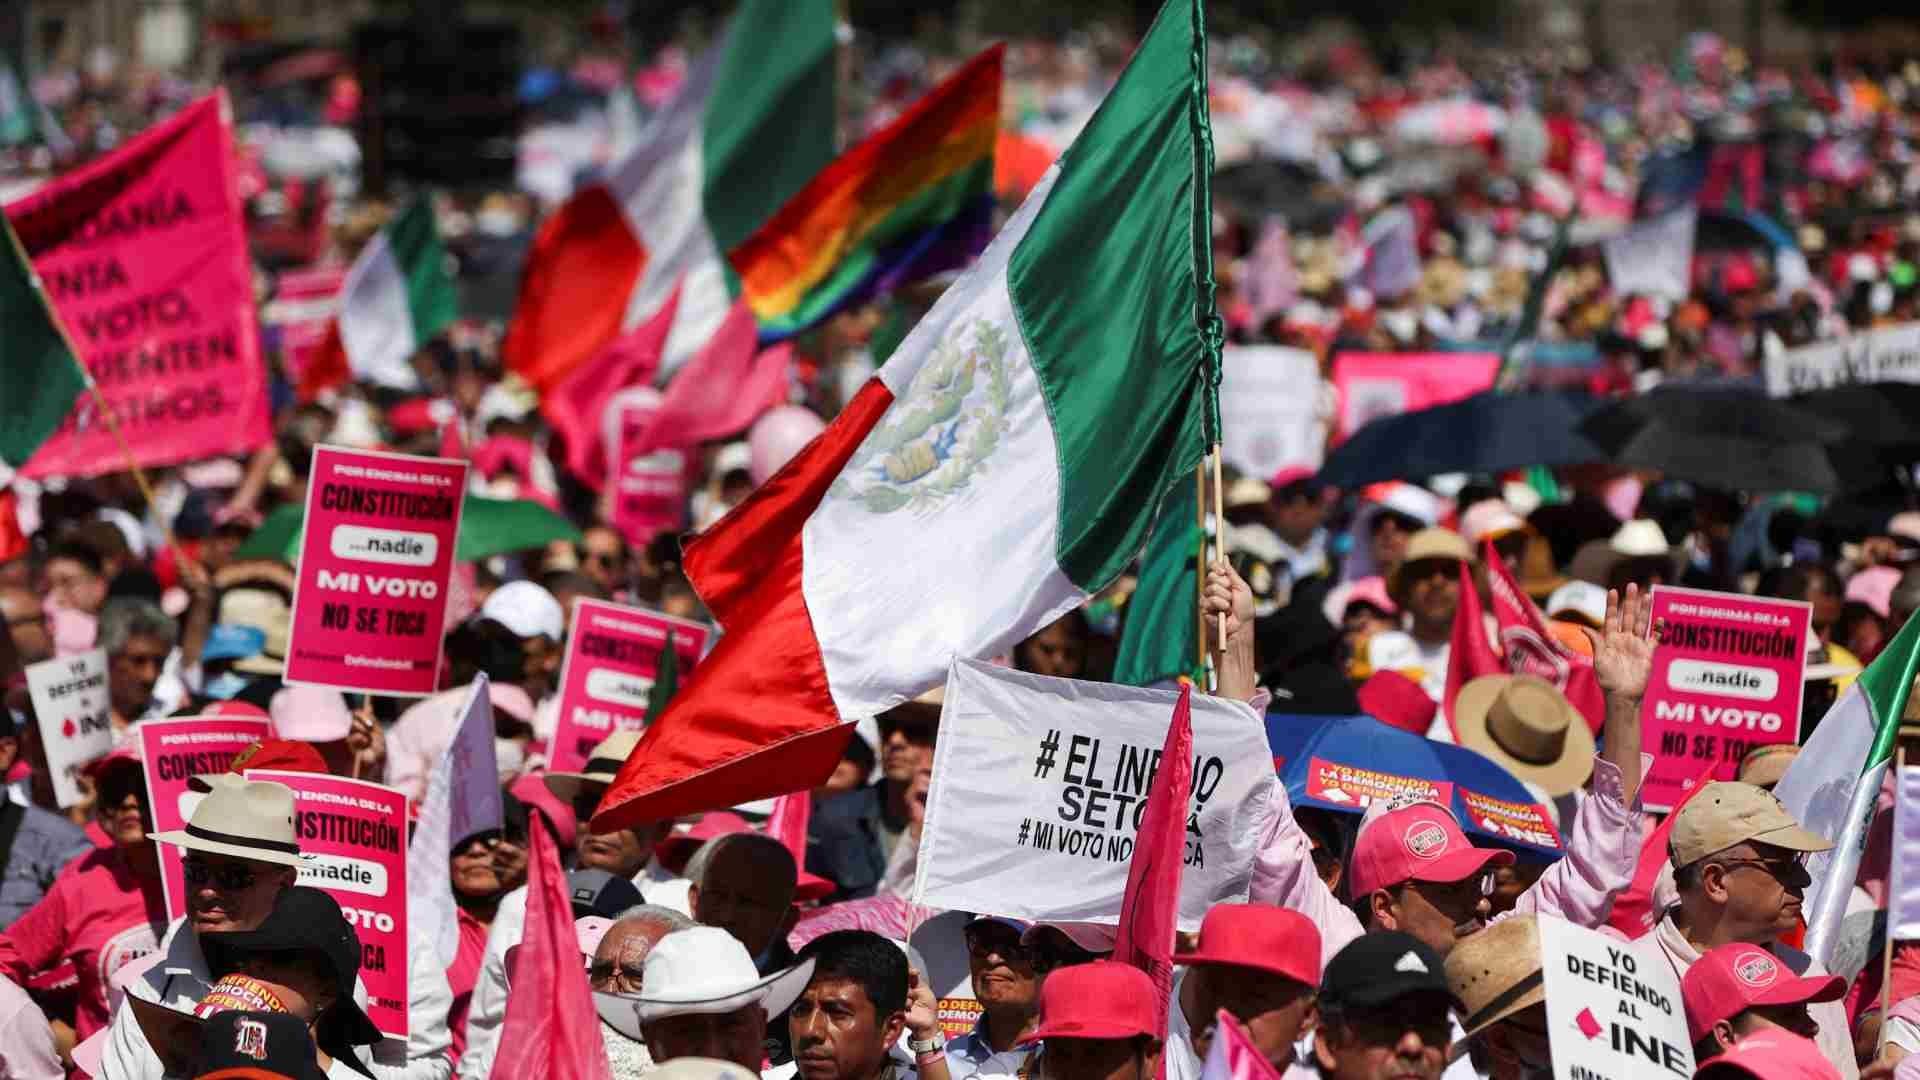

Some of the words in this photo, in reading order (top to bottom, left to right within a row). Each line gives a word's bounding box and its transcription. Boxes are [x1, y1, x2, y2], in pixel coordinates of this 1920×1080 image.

[321, 483, 453, 521] CONSTITUCIÓN
[317, 569, 360, 593] MI
[365, 576, 438, 600] VOTO
[321, 602, 350, 631] NO
[356, 606, 379, 634] SE
[385, 608, 428, 637] TOCA
[1669, 602, 1697, 614] POR
[1659, 620, 1797, 660] CONSTITUCIÓN
[572, 706, 611, 730] MI
[1656, 700, 1695, 722] MI
[1701, 705, 1782, 733] VOTO
[1034, 729, 1060, 779] #
[1063, 734, 1103, 789] EL
[1661, 732, 1687, 756] NO
[1693, 735, 1715, 760] SE
[1723, 738, 1757, 764] TO
[158, 751, 238, 781] CONSTIT
[1334, 764, 1352, 775] YO
[1355, 768, 1432, 788] DEFIENDO
[1320, 767, 1338, 779] LA
[1342, 774, 1440, 797] DEMOCRACIA
[1320, 777, 1340, 788] YO
[1343, 783, 1393, 799] DEFIEN
[302, 790, 359, 807] ENCIMA
[360, 800, 376, 811] DE
[377, 803, 393, 815] LA
[295, 810, 399, 856] NSTITUCIÓN
[1017, 818, 1031, 845] #
[1033, 825, 1053, 852] MI
[1058, 830, 1104, 859] VOTO
[1107, 835, 1133, 862] NO
[340, 906, 395, 933] OTO
[360, 943, 386, 974] CA
[1606, 946, 1637, 974] YO
[1567, 954, 1672, 1016] DEFIENDO
[951, 1000, 985, 1011] DEFI
[1618, 999, 1643, 1021] AL
[1610, 1022, 1690, 1079] INE
